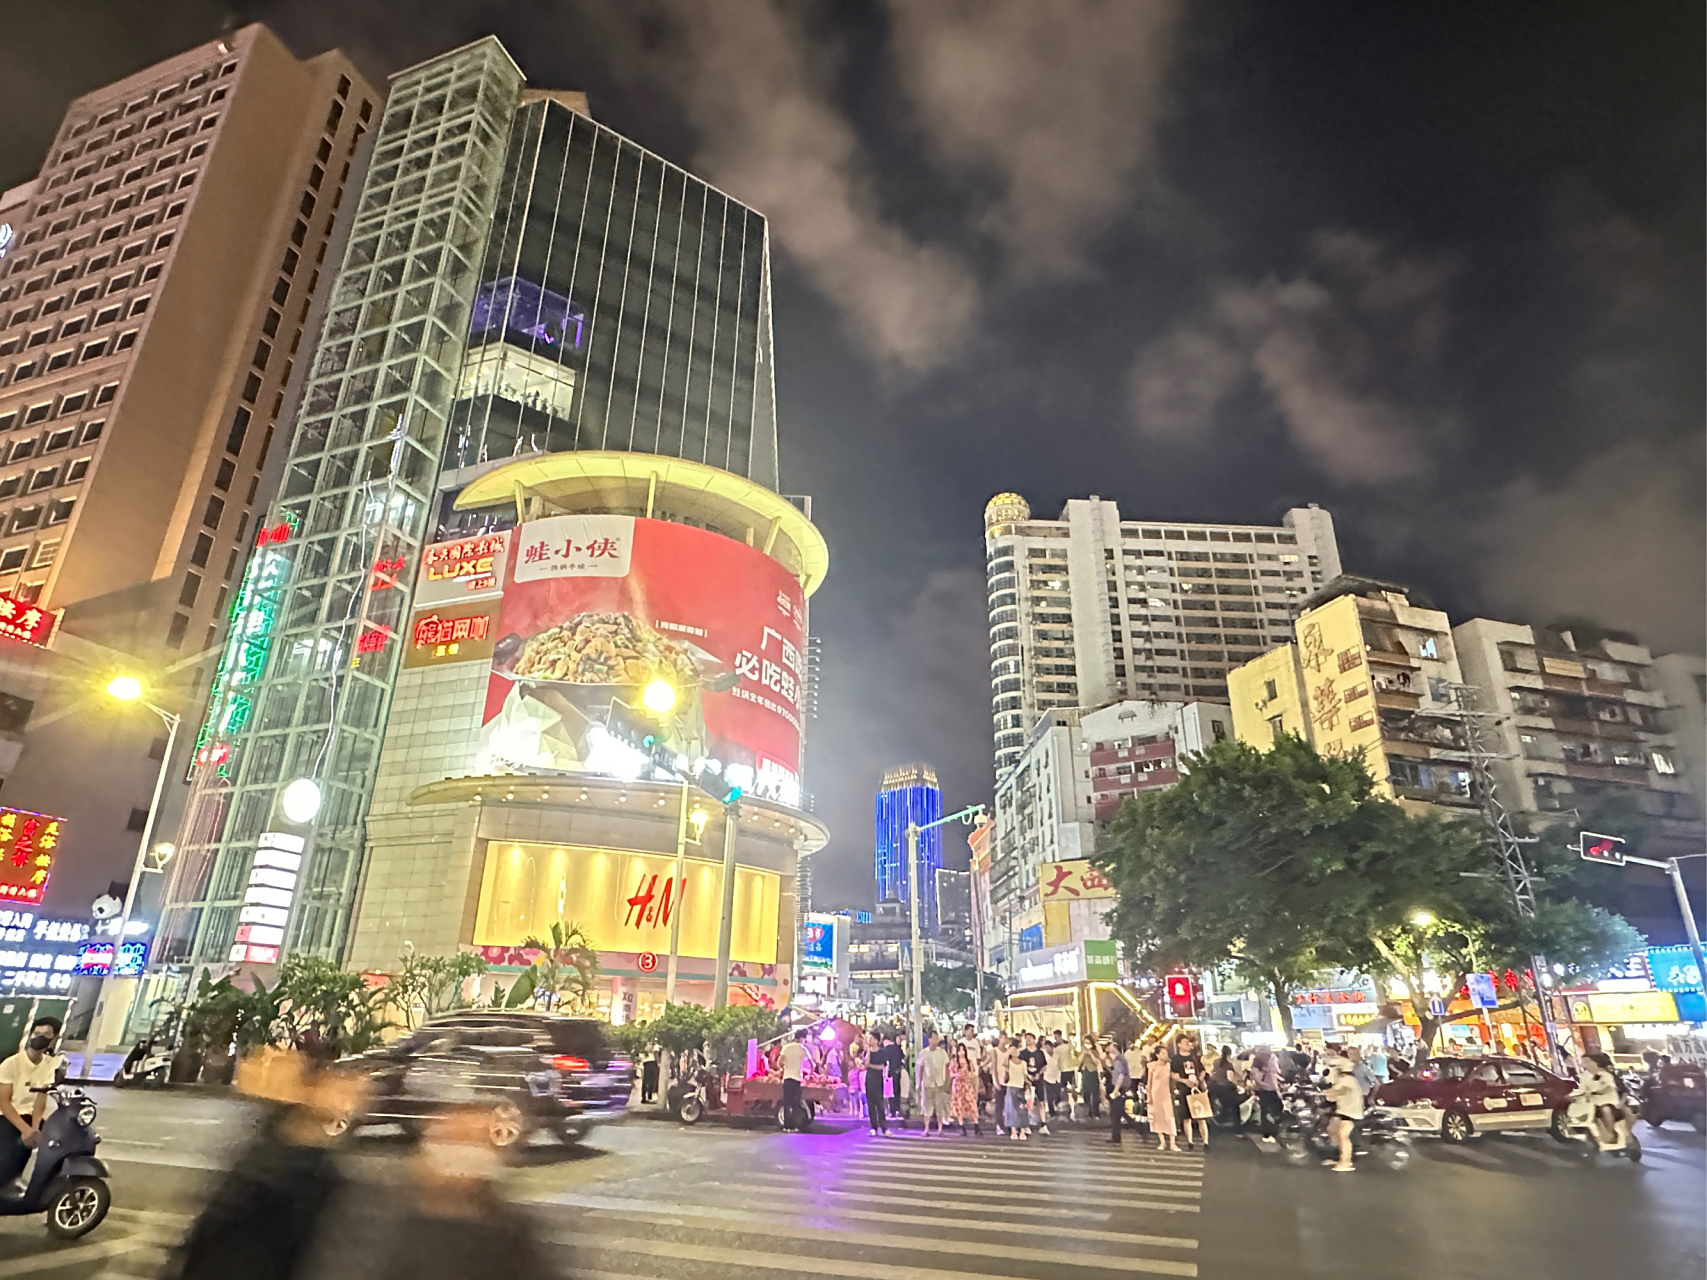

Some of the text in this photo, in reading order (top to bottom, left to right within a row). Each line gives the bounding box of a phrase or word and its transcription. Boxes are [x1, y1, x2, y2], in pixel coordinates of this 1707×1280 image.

[524, 537, 620, 564] 蛙小侠
[427, 556, 495, 581] LUXE
[624, 873, 687, 930] H&M
